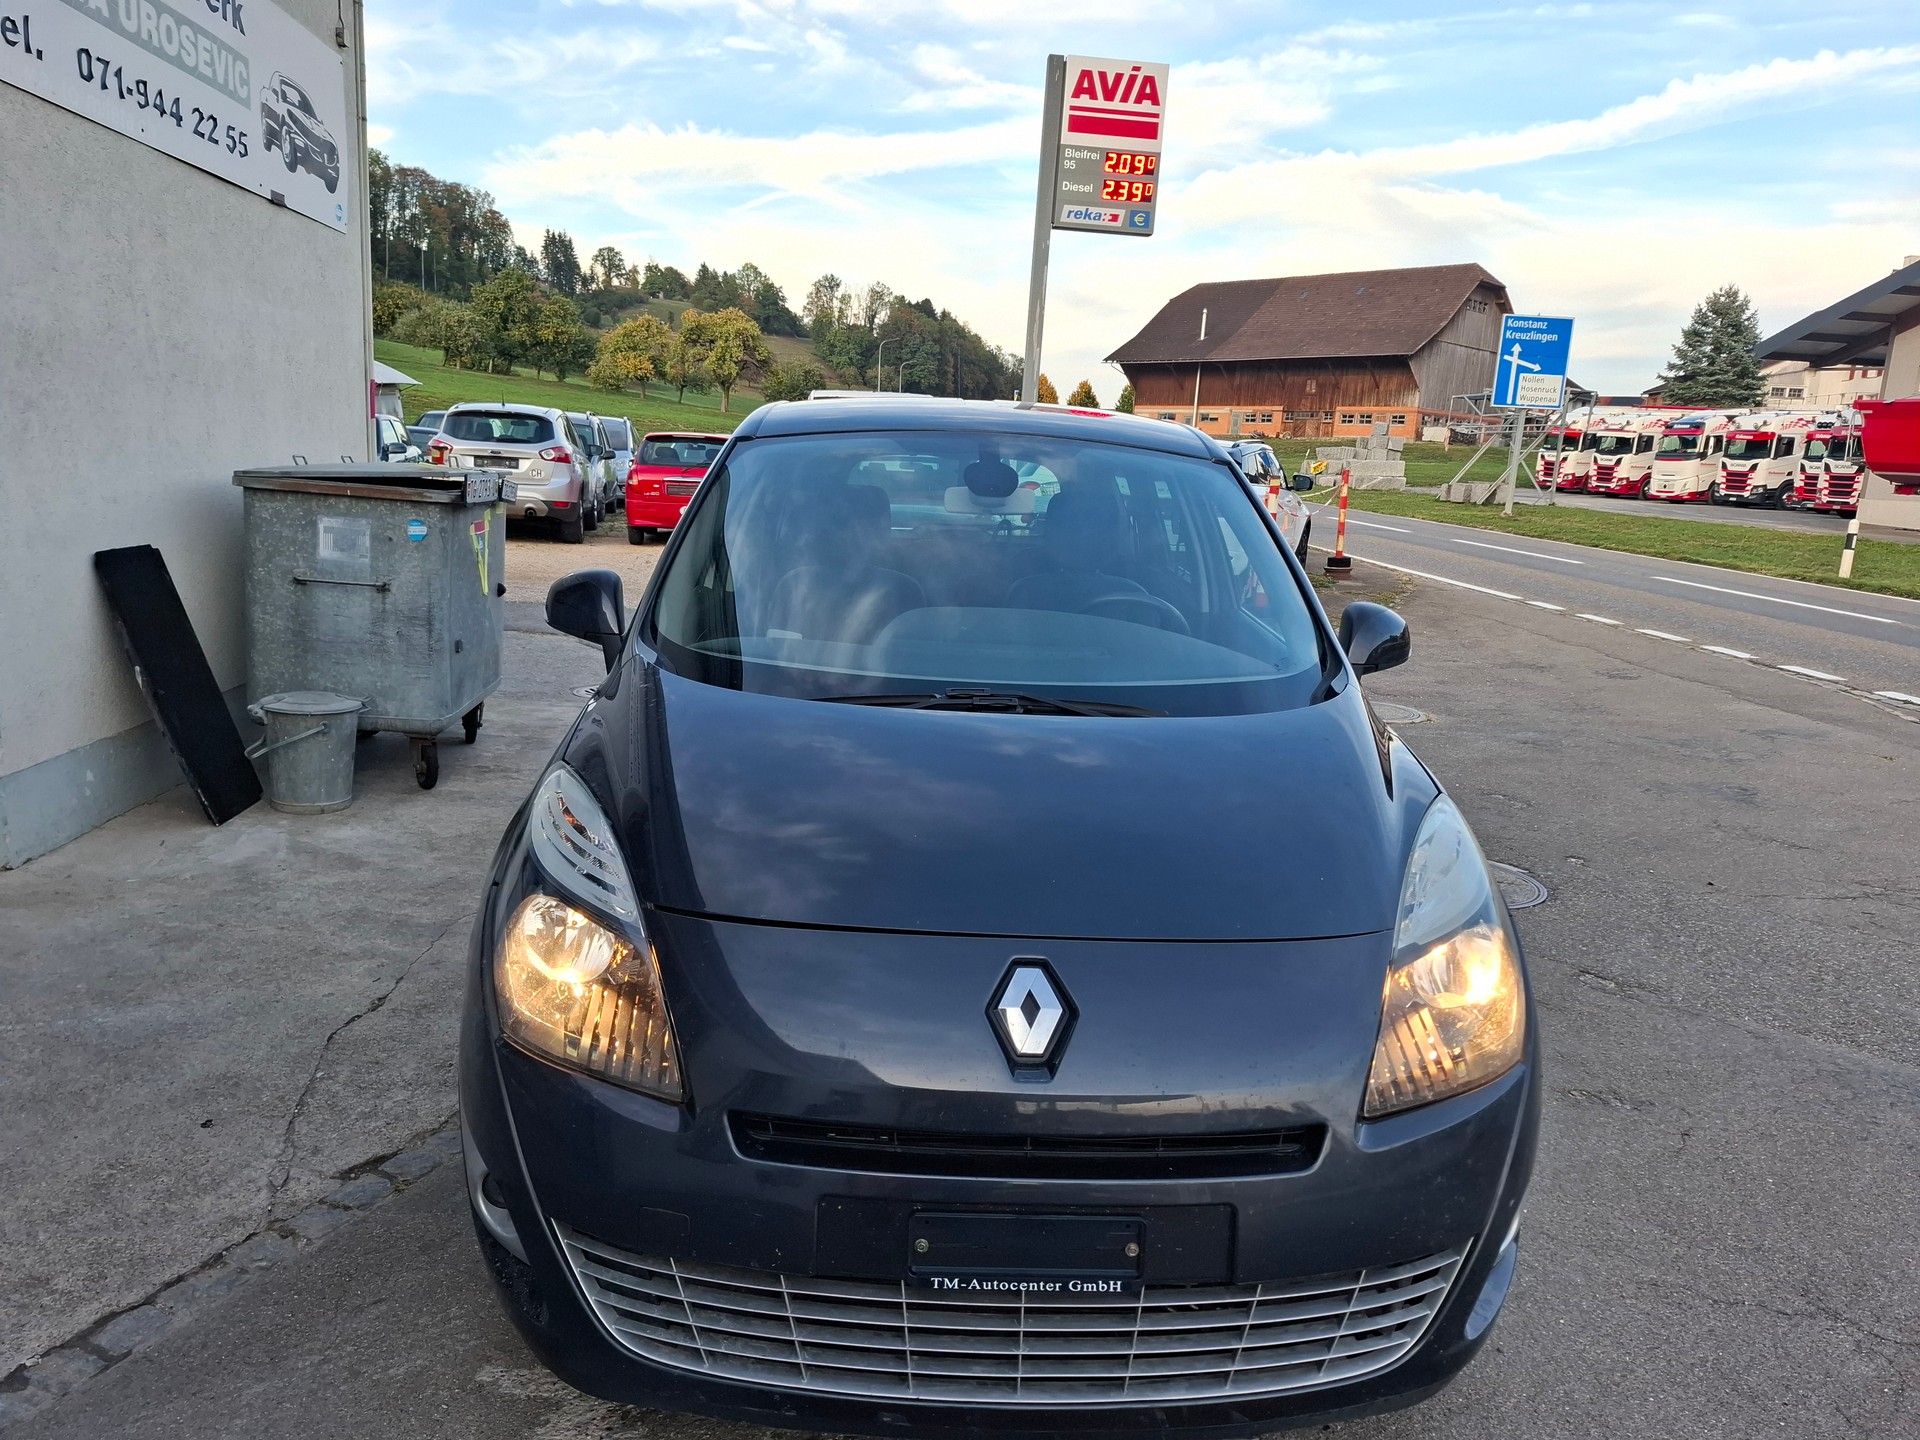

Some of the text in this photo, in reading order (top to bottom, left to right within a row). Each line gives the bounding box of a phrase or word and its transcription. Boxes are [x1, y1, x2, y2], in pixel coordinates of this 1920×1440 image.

[119, 0, 249, 99] UROSEVIC
[1071, 66, 1161, 106] AVIA
[77, 48, 183, 128] 071-944
[192, 107, 220, 146] 22
[226, 125, 249, 158] 55
[1065, 148, 1100, 160] Bleifrei
[1063, 160, 1076, 169] 95
[1062, 181, 1093, 193] Diesel
[1507, 318, 1548, 329] Konstanz
[1505, 330, 1558, 343] Kreuzlingen
[1522, 375, 1545, 384] Nollen
[1520, 385, 1557, 394] Hosenruck
[1519, 394, 1557, 404] Wuppenau
[531, 468, 542, 478] CH
[931, 1277, 1123, 1293] TM-Autocenter GmbH
